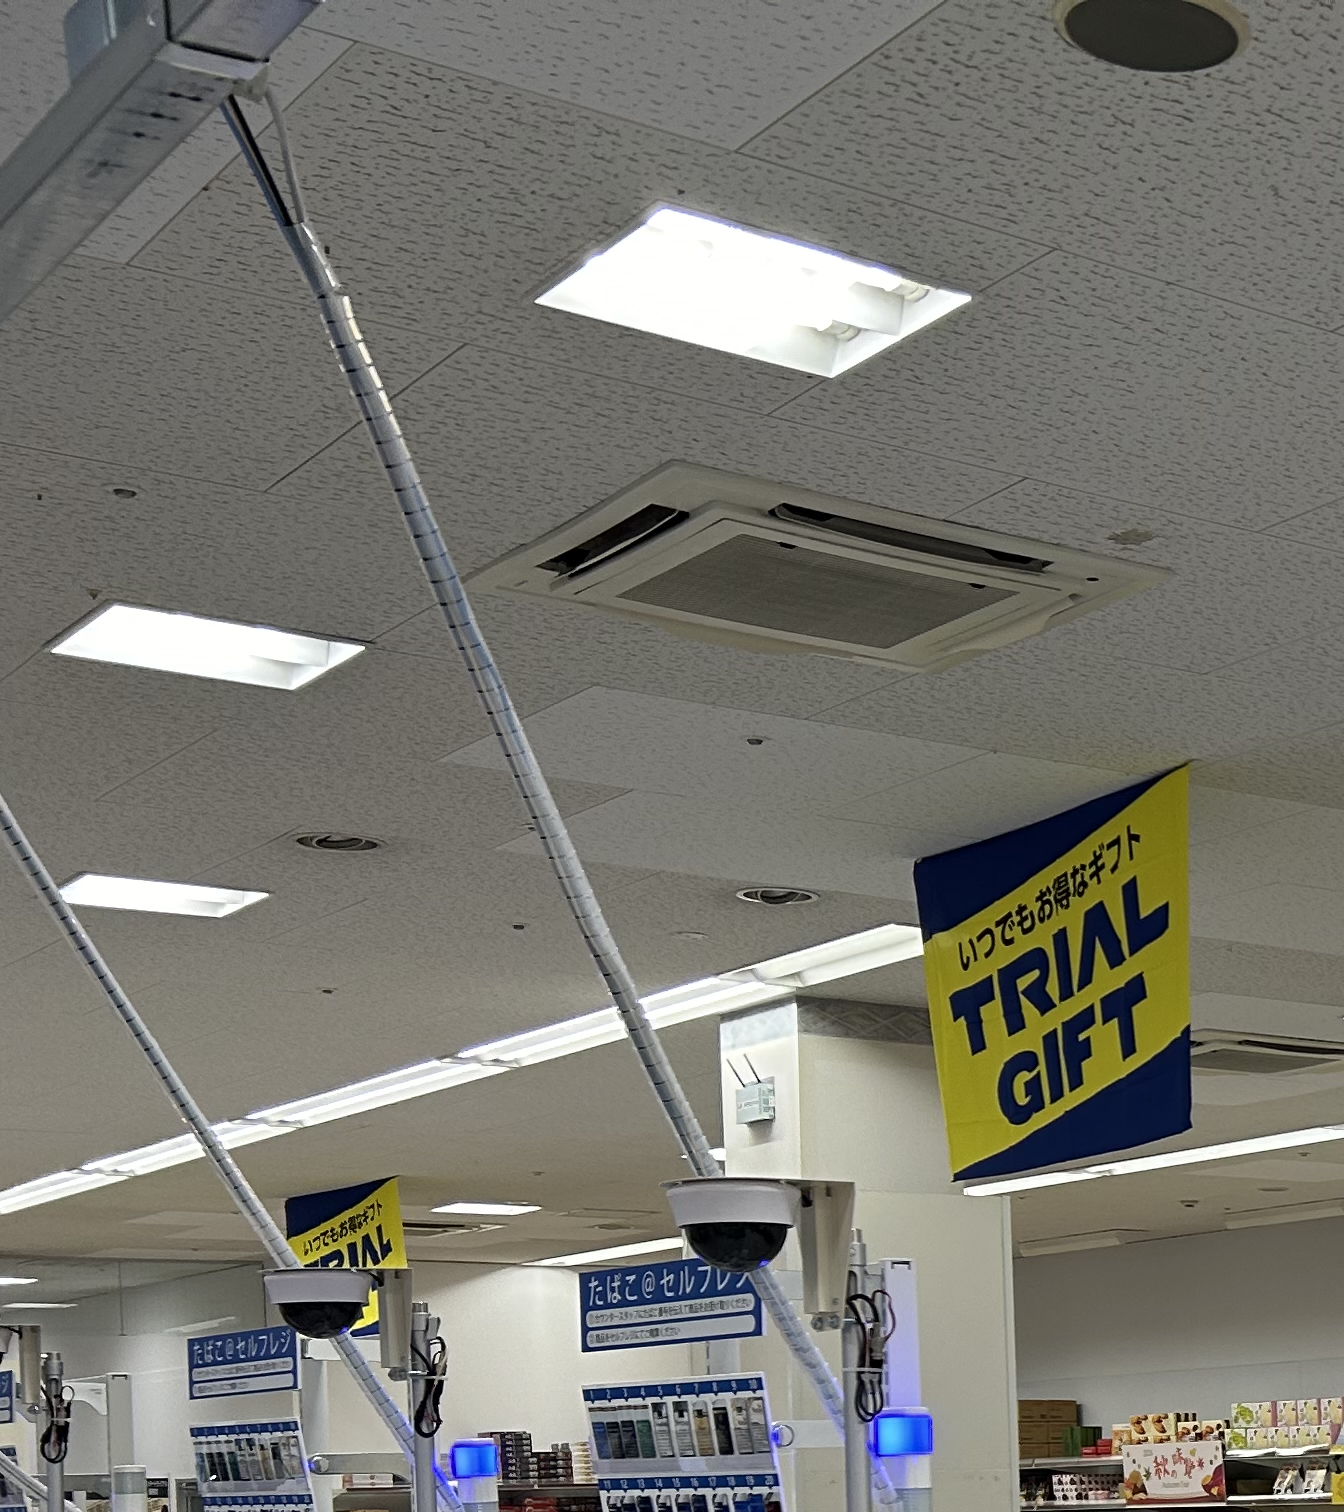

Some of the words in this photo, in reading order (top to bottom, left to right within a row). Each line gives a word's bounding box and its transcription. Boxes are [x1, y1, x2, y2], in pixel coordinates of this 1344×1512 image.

[949, 875, 1169, 1056] TRIAL
[958, 825, 1141, 971] いつでもお得なギフト
[998, 972, 1147, 1125] GIFT
[192, 1327, 291, 1365] たばこ@セルフレジ
